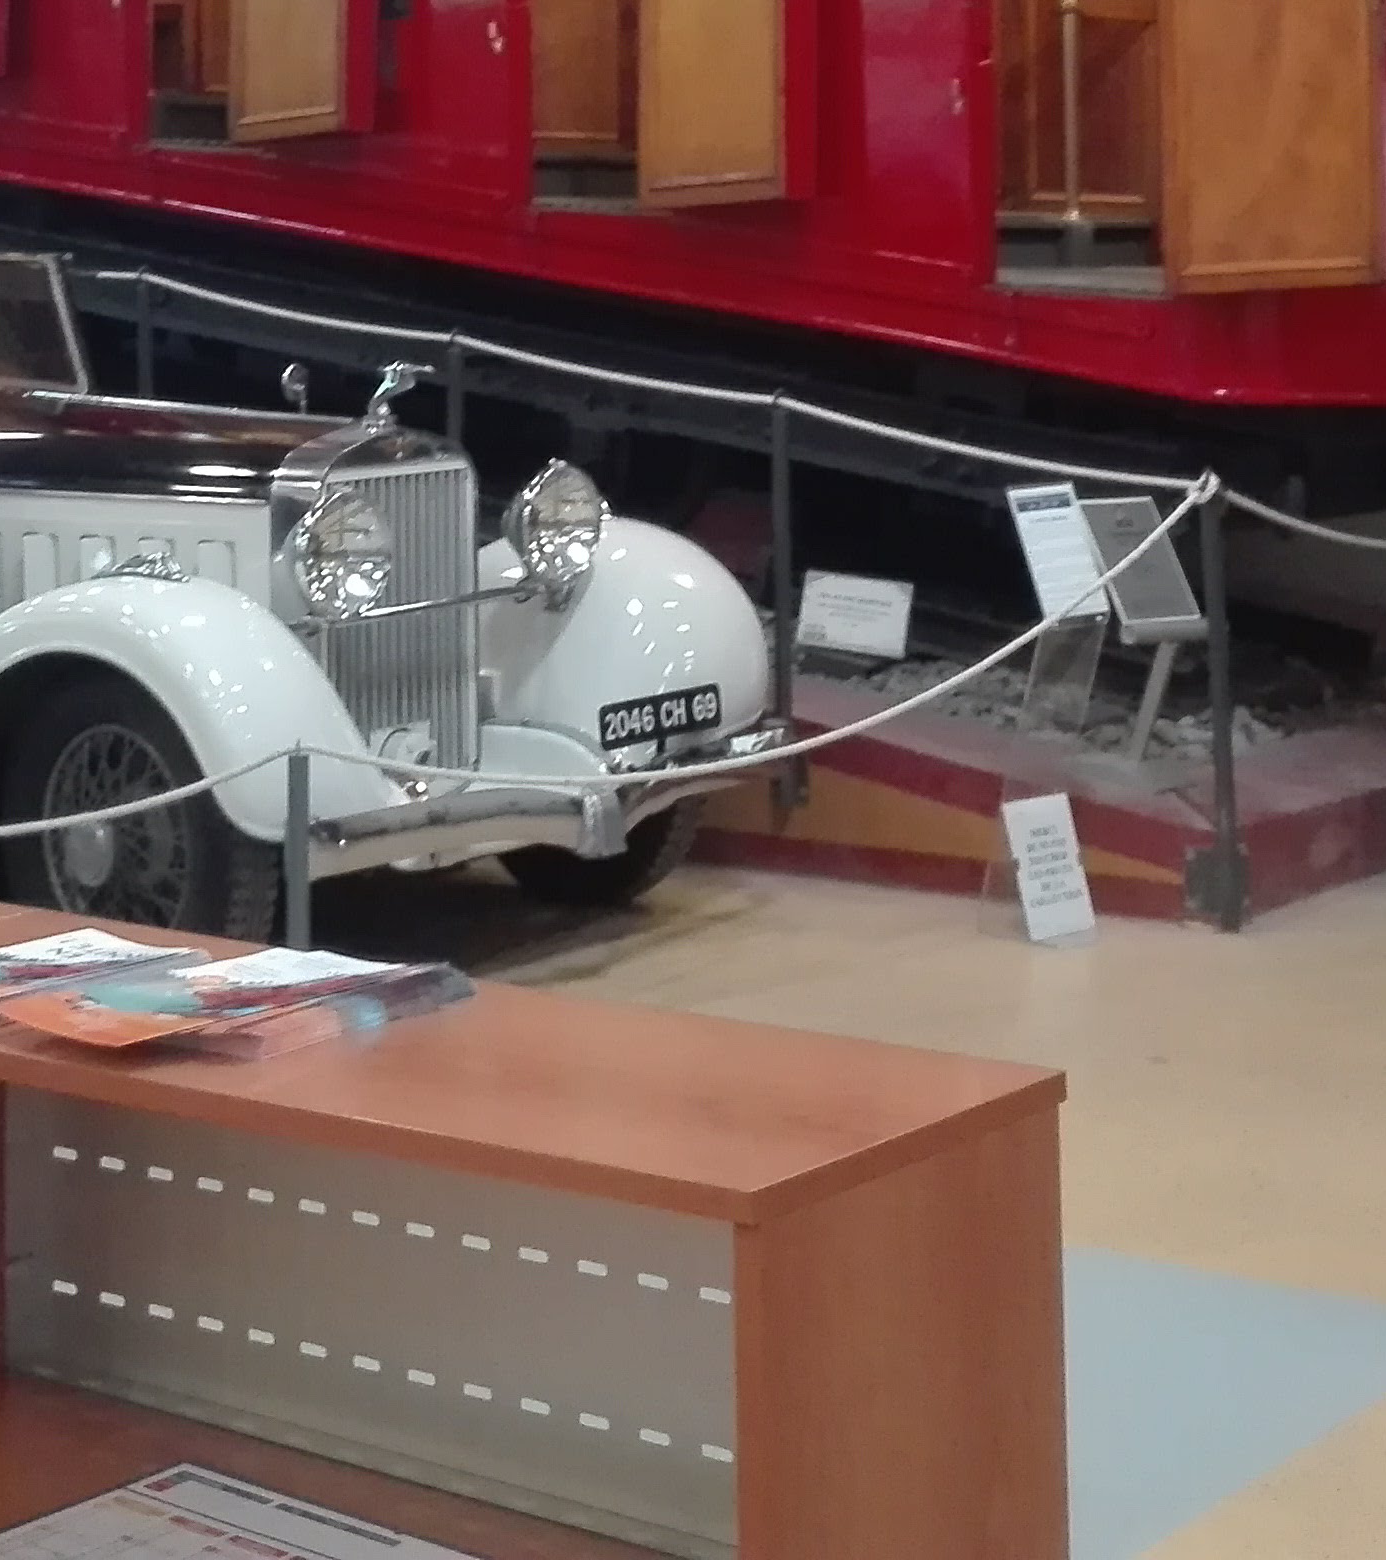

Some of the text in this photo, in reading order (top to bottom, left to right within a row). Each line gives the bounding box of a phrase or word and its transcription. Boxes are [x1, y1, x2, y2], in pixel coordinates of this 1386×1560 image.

[604, 692, 718, 741] 2046 CH 69
